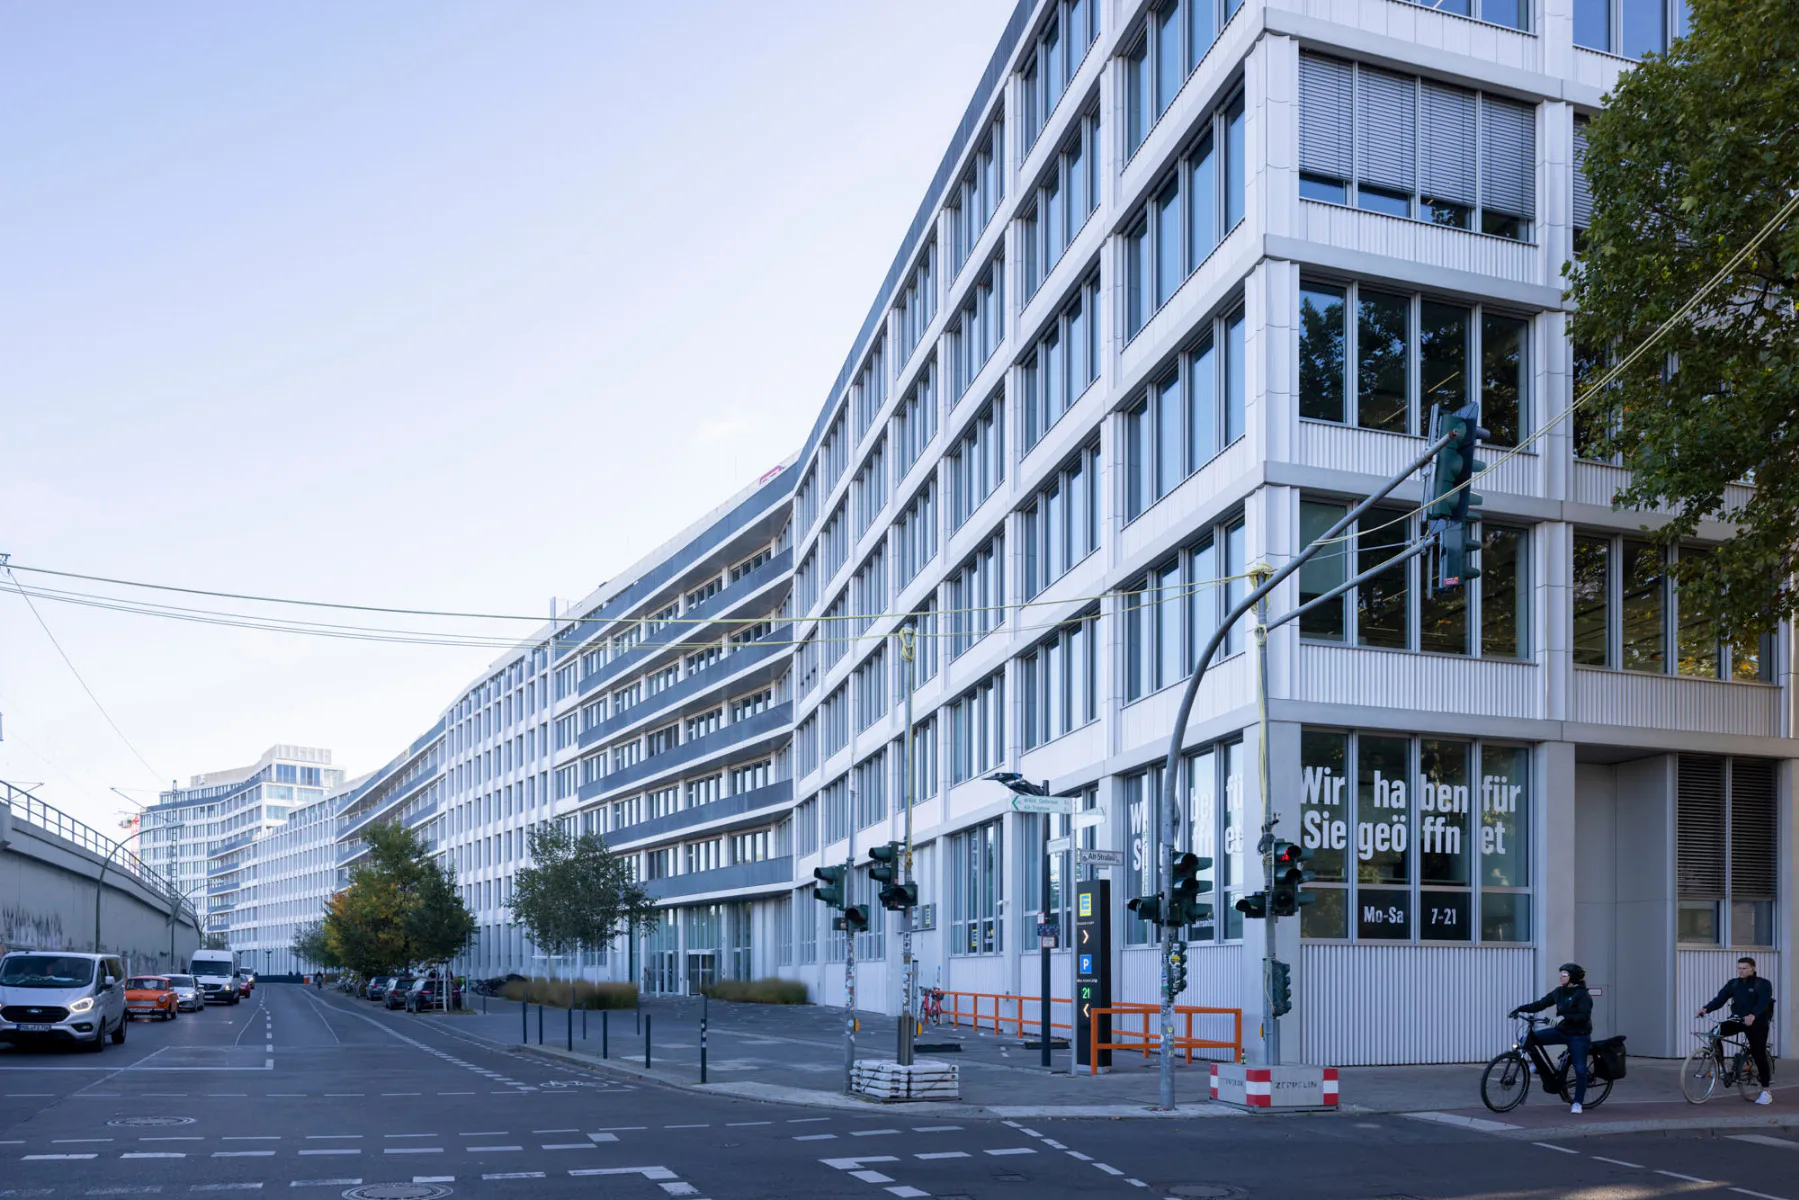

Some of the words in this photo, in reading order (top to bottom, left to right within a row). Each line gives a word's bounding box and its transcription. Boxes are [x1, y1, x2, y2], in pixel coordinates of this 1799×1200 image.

[1300, 766, 1346, 805] Wir
[1482, 775, 1521, 812] für
[1303, 810, 1346, 849] Sie
[1364, 906, 1404, 924] Mo-Sa
[1431, 908, 1457, 925] 7-21
[1083, 958, 1090, 971] P
[1082, 987, 1091, 999] 21
[1275, 1080, 1318, 1090] ZEPPELIN
